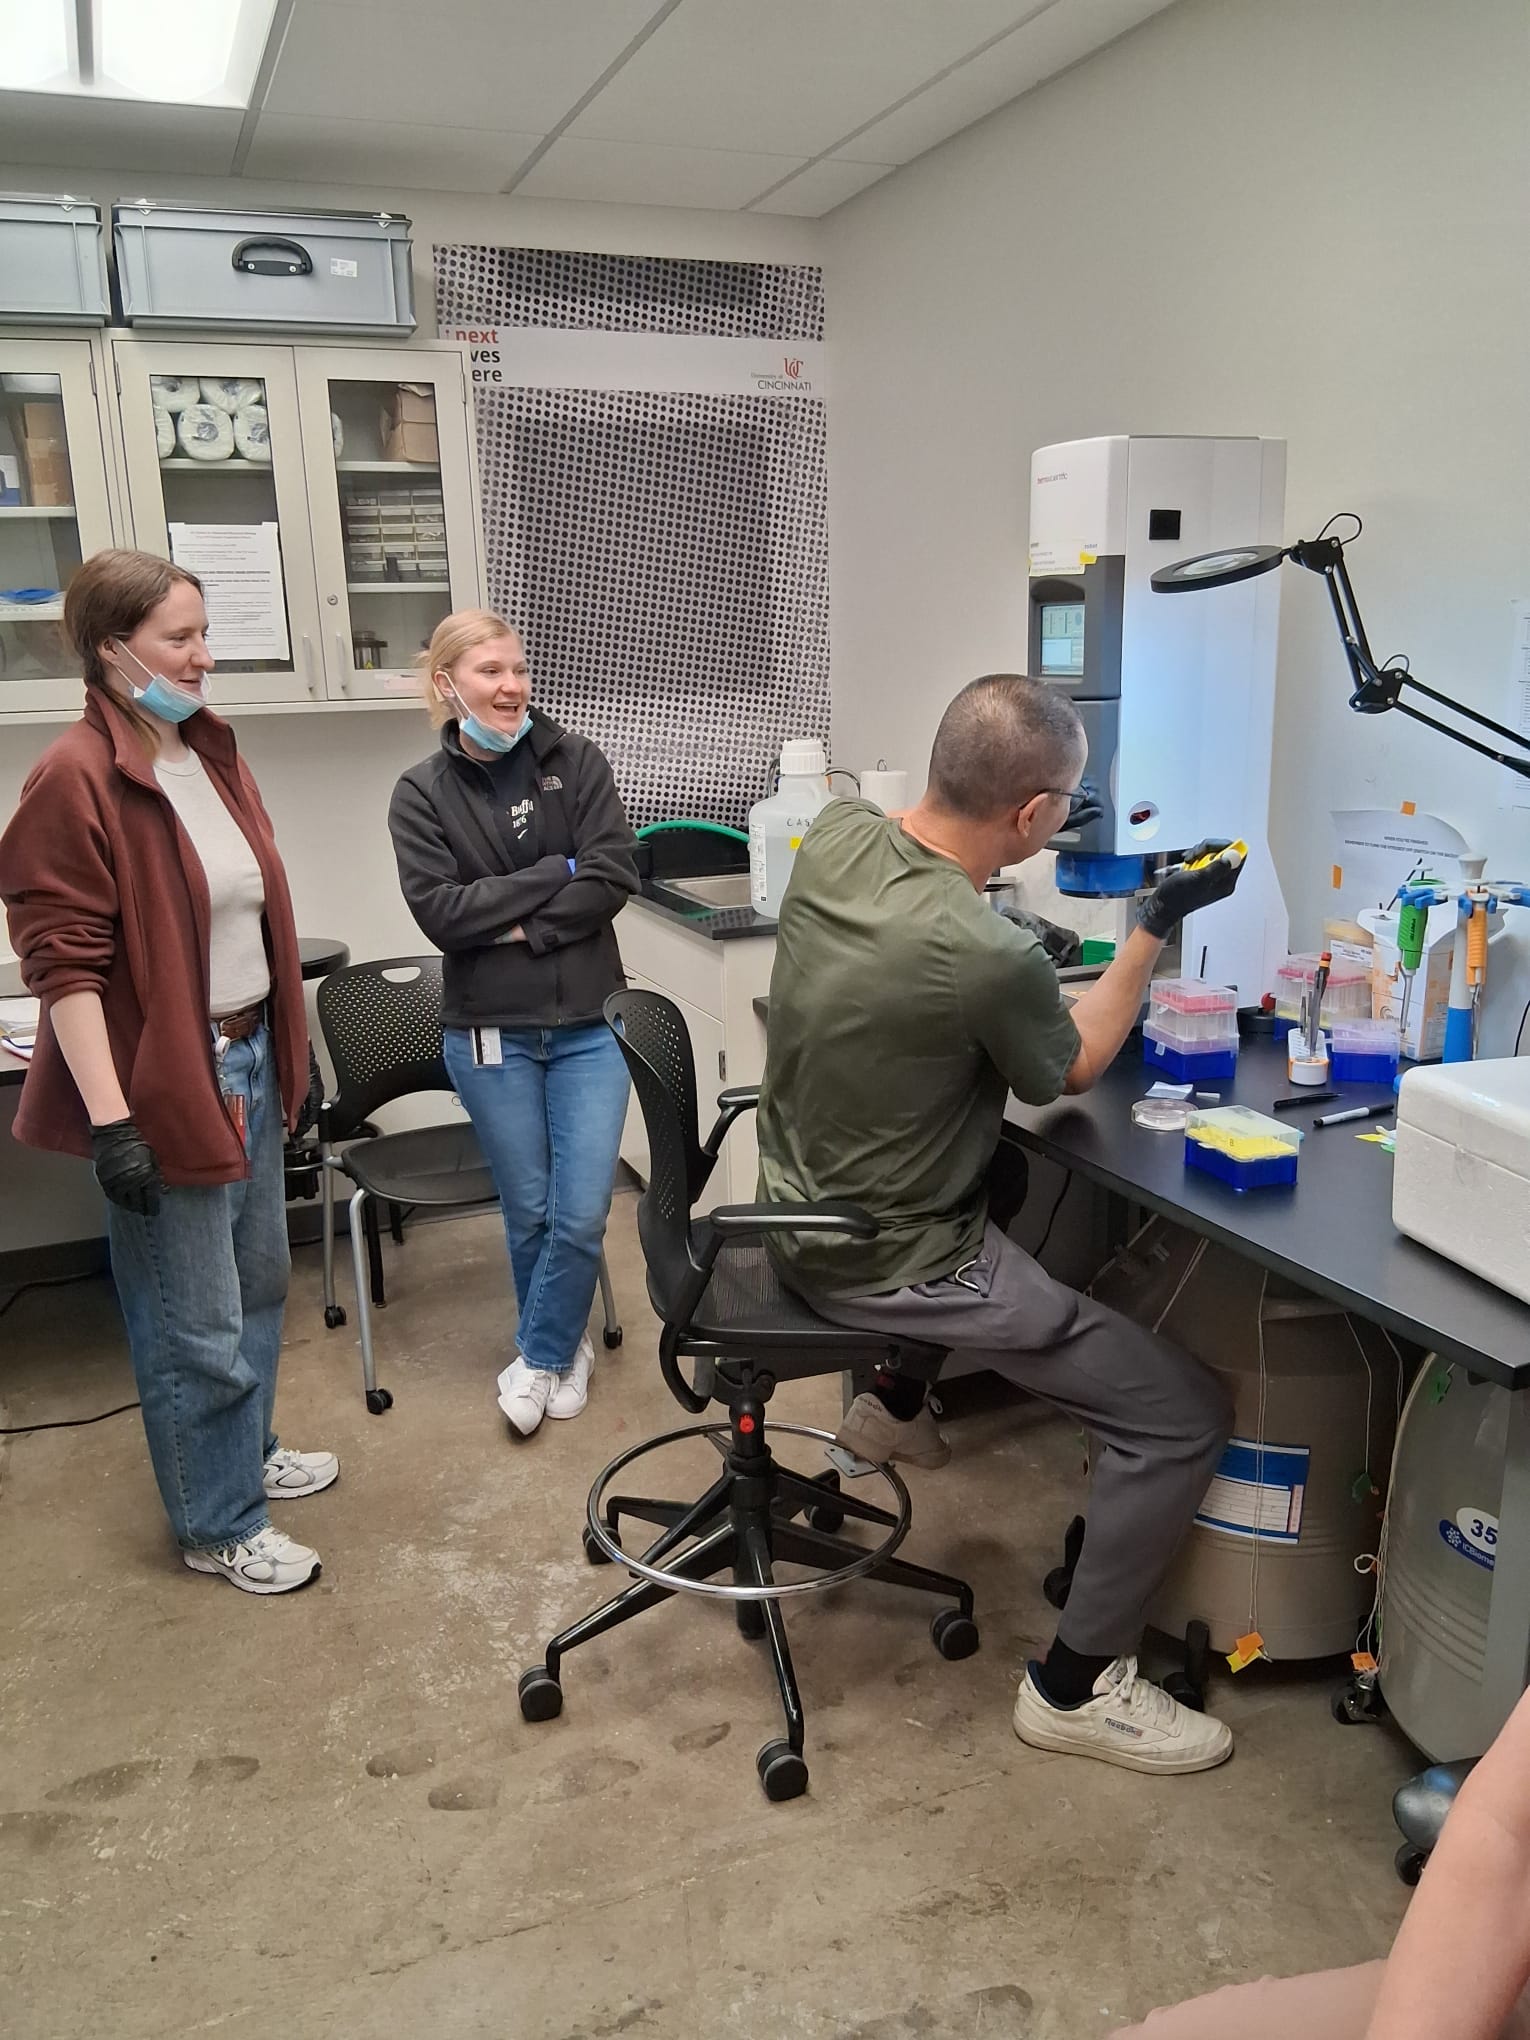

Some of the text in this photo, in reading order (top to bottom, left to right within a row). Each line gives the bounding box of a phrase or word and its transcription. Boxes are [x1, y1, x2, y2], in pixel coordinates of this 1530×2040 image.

[456, 329, 499, 343] next
[471, 350, 500, 363] ves
[472, 369, 503, 382] ere
[758, 380, 812, 391] CINCINNATI
[510, 798, 535, 817] Buffl
[1471, 1519, 1498, 1545] 35
